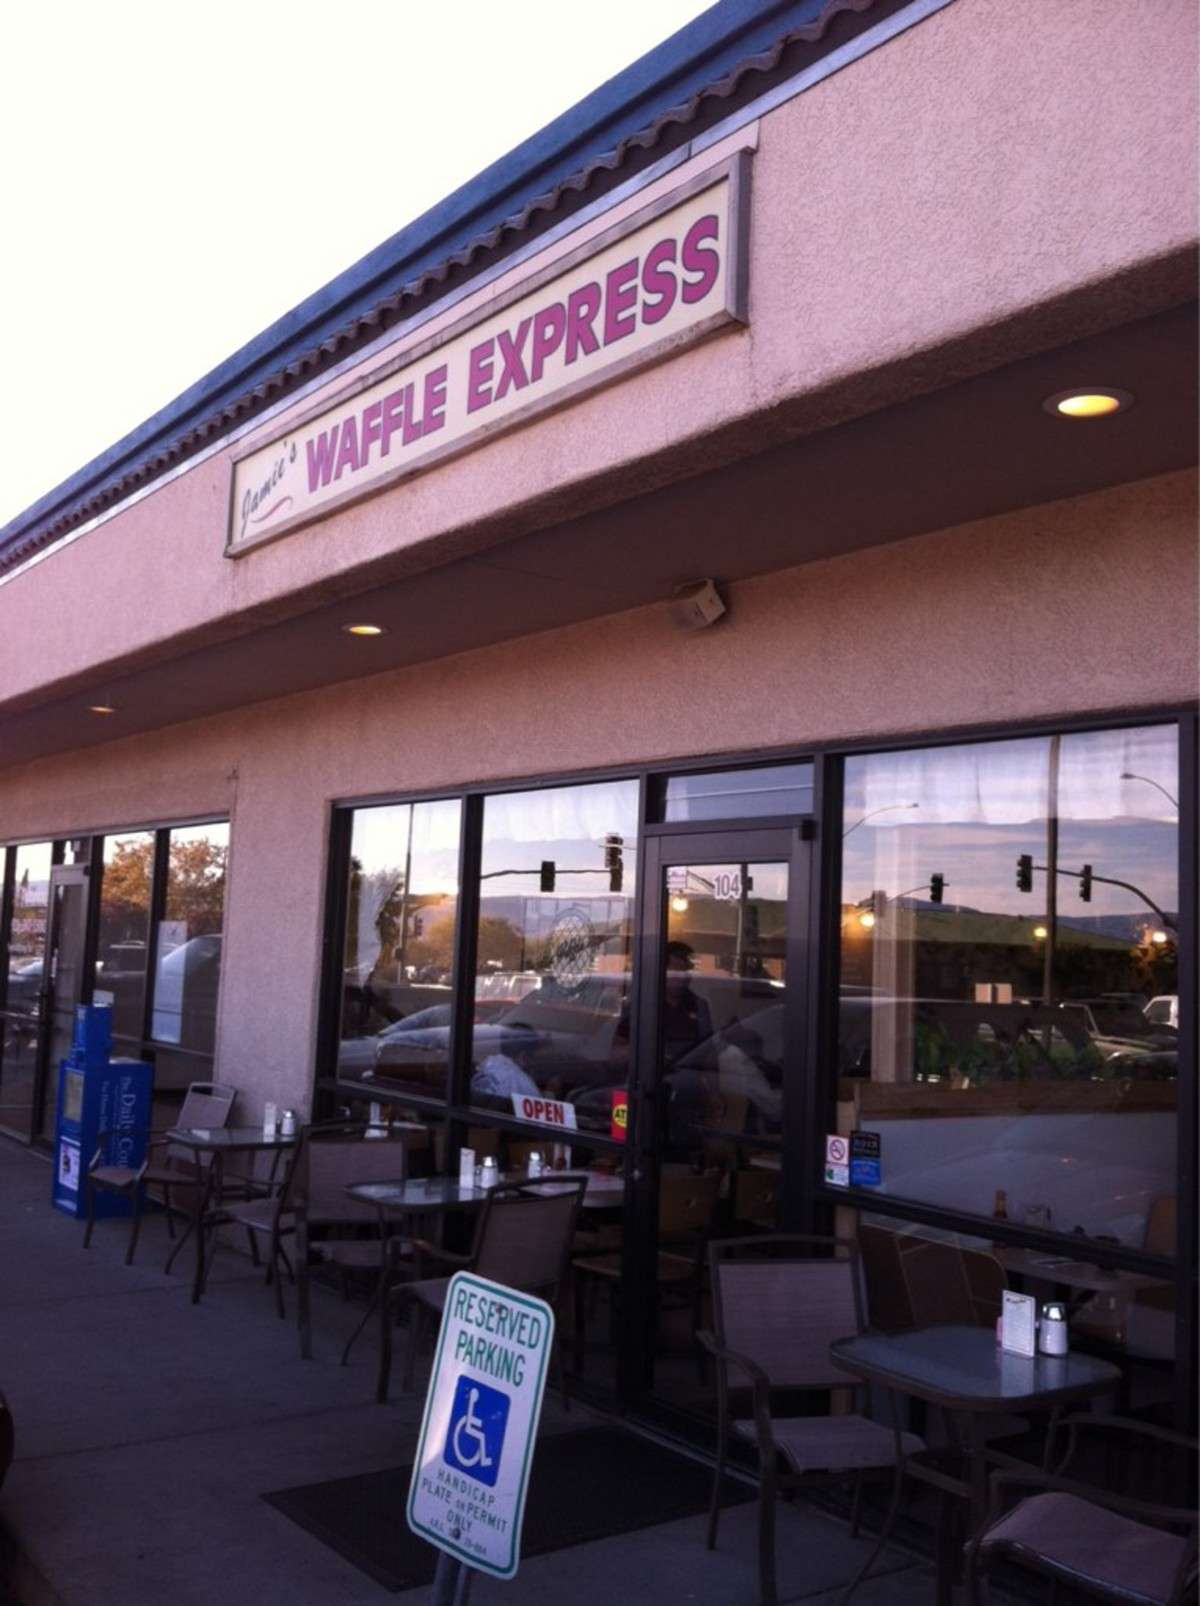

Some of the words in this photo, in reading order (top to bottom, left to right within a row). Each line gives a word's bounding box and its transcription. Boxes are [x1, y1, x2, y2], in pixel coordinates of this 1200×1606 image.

[241, 440, 297, 538] Jamie's
[304, 364, 449, 493] WAFFLE
[466, 213, 721, 416] EXPRESS
[714, 873, 740, 897] 104
[117, 1094, 136, 1129] Daily
[522, 1097, 565, 1125] OPEN
[454, 1287, 542, 1349] RESERVED
[455, 1329, 526, 1387] PARKING
[421, 1477, 452, 1504] PLATE
[467, 1502, 508, 1533] PERMIT
[437, 1468, 496, 1507] HANDICAP
[446, 1508, 473, 1533] ONLY
